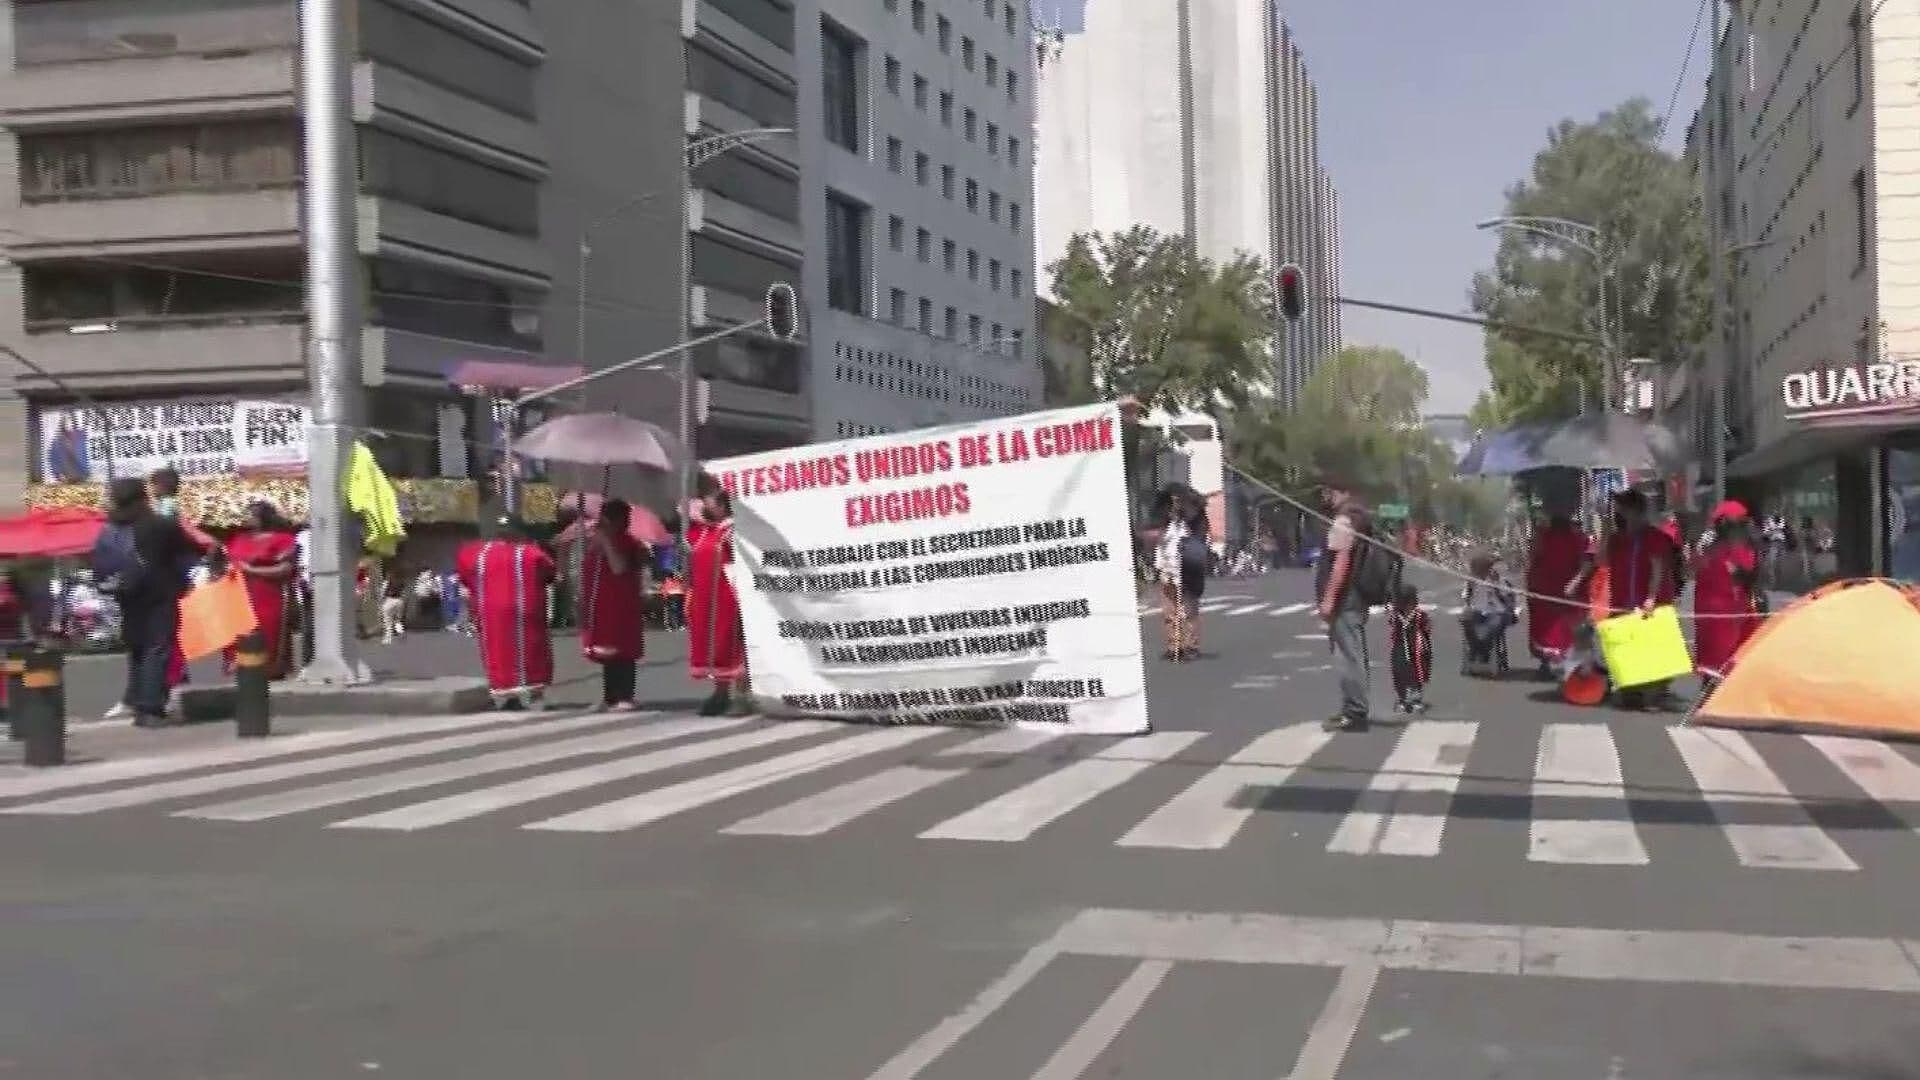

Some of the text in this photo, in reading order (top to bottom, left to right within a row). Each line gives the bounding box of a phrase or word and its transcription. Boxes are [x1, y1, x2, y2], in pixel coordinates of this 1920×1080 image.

[247, 406, 301, 424] BUEN
[181, 427, 235, 455] TIENDA
[713, 417, 1113, 498] RTESANOS UNIDOS DE LA CDMX
[846, 483, 970, 527] EXIGIMOS
[809, 543, 873, 567] TRABAJO
[877, 538, 908, 562] CON
[911, 536, 927, 557] EL
[929, 523, 1021, 555] SECRETARIO
[1024, 517, 1066, 543] PARA
[1069, 515, 1087, 539] LA
[871, 568, 881, 588] A
[883, 565, 911, 587] LAS
[914, 549, 1026, 585] COMUNIDADES
[844, 616, 907, 641] ENTREGA
[908, 613, 927, 636] DE
[928, 606, 1012, 634] VIVIENDAS
[857, 637, 962, 667] COMUNIDADES
